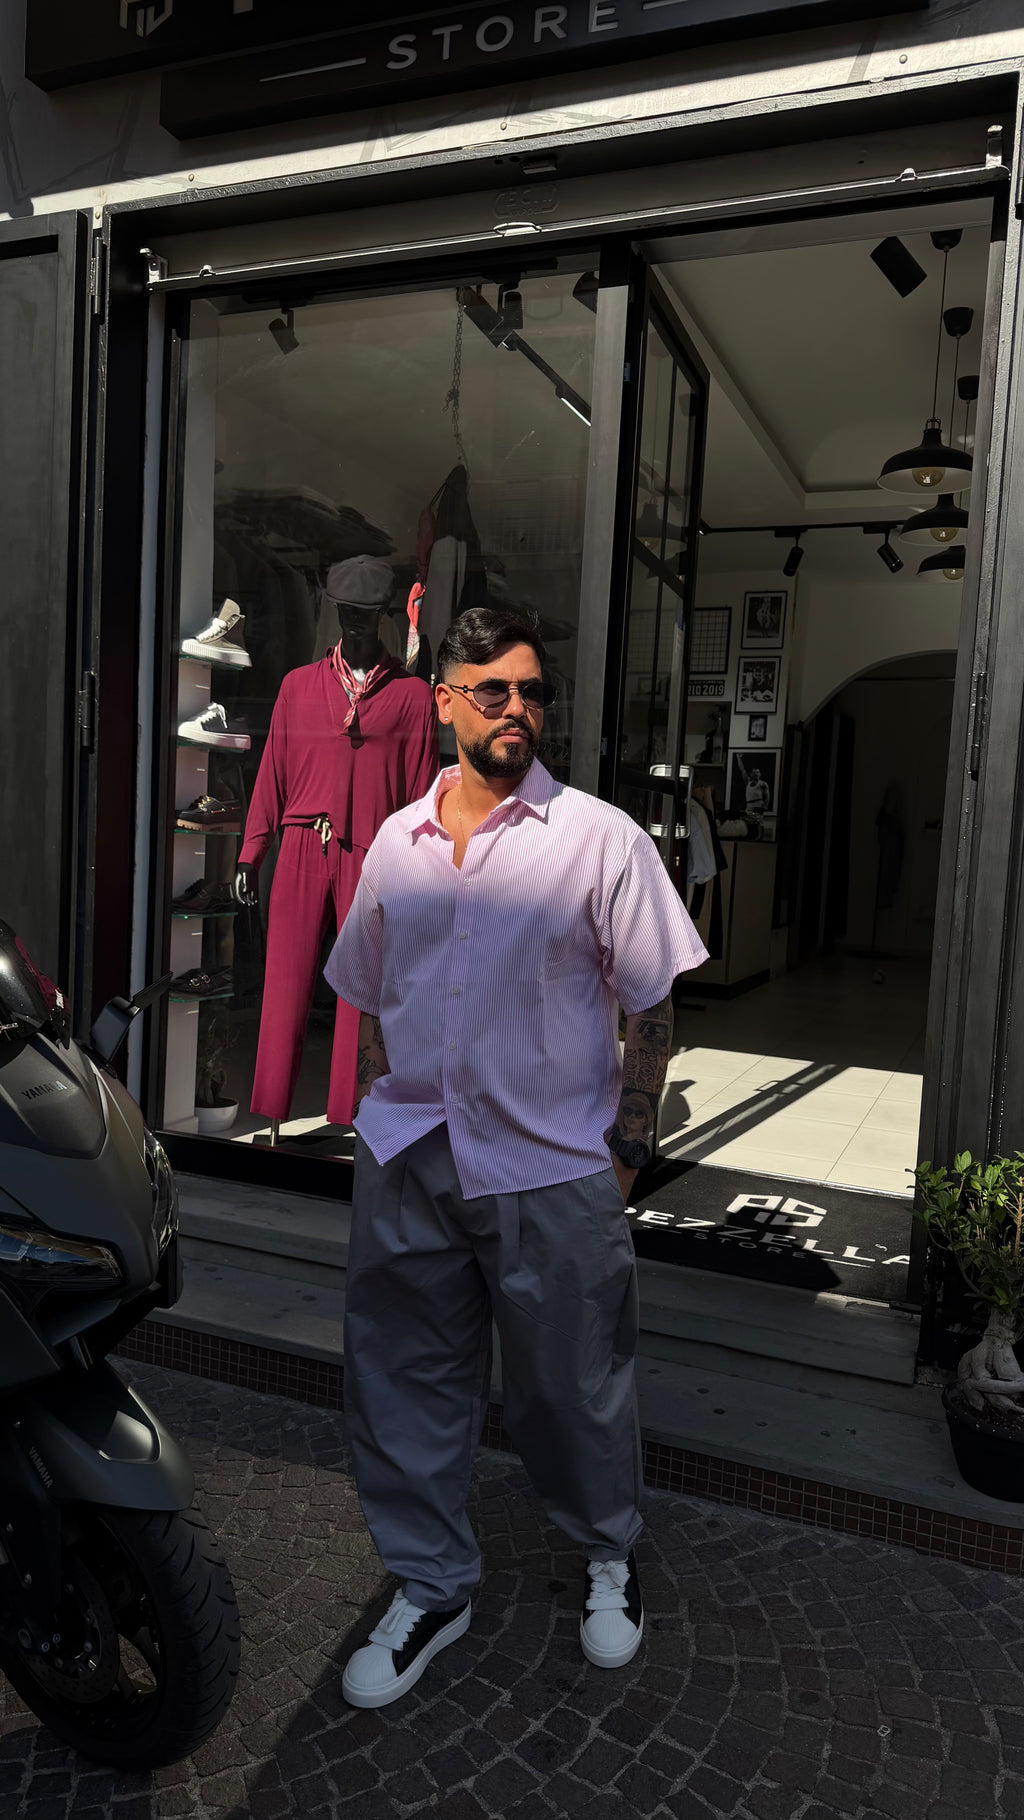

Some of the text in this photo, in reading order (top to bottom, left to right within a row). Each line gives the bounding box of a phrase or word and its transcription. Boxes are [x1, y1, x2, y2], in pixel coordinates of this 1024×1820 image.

[386, 0, 619, 70] STORE
[702, 684, 724, 696] 2019
[693, 1232, 808, 1258] STORE
[28, 1446, 53, 1488] YAMAHA
